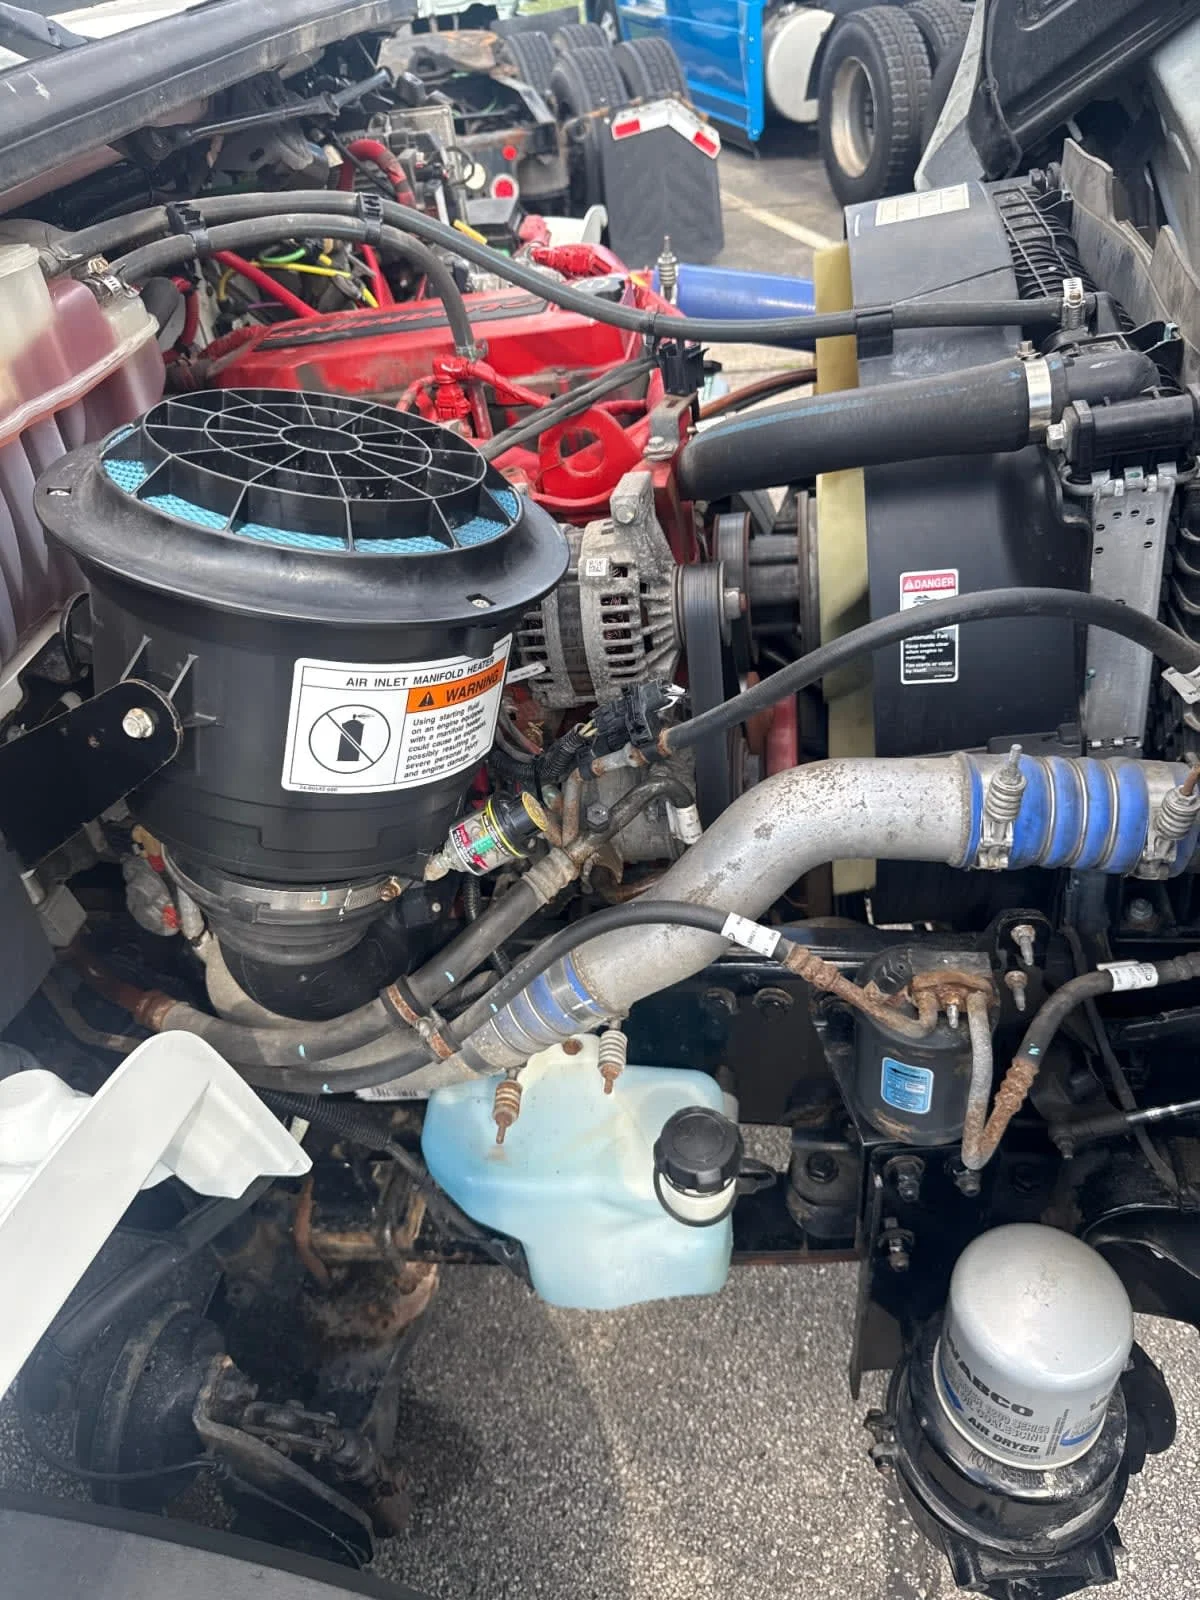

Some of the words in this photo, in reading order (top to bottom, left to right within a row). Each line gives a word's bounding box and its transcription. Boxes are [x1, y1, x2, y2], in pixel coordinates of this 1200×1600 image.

[915, 577, 955, 589] DANGER
[346, 677, 367, 687] AIR
[374, 677, 408, 687] INLET
[413, 668, 464, 685] MANIFOLD
[467, 657, 495, 674] HEATER
[445, 670, 499, 702] WARNING
[413, 717, 435, 727] Using
[439, 709, 465, 721] starting
[437, 719, 459, 730] engine
[410, 735, 426, 744] with
[436, 725, 464, 739] manifold
[407, 749, 439, 763] possibly
[442, 738, 469, 753] resulting
[408, 743, 430, 752] could
[432, 738, 452, 748] cause
[405, 760, 431, 770] severe
[434, 748, 462, 764] personal
[404, 770, 419, 778] and
[421, 763, 444, 774] engine
[968, 1417, 990, 1436] AIR
[992, 1433, 1041, 1453] DRYER
